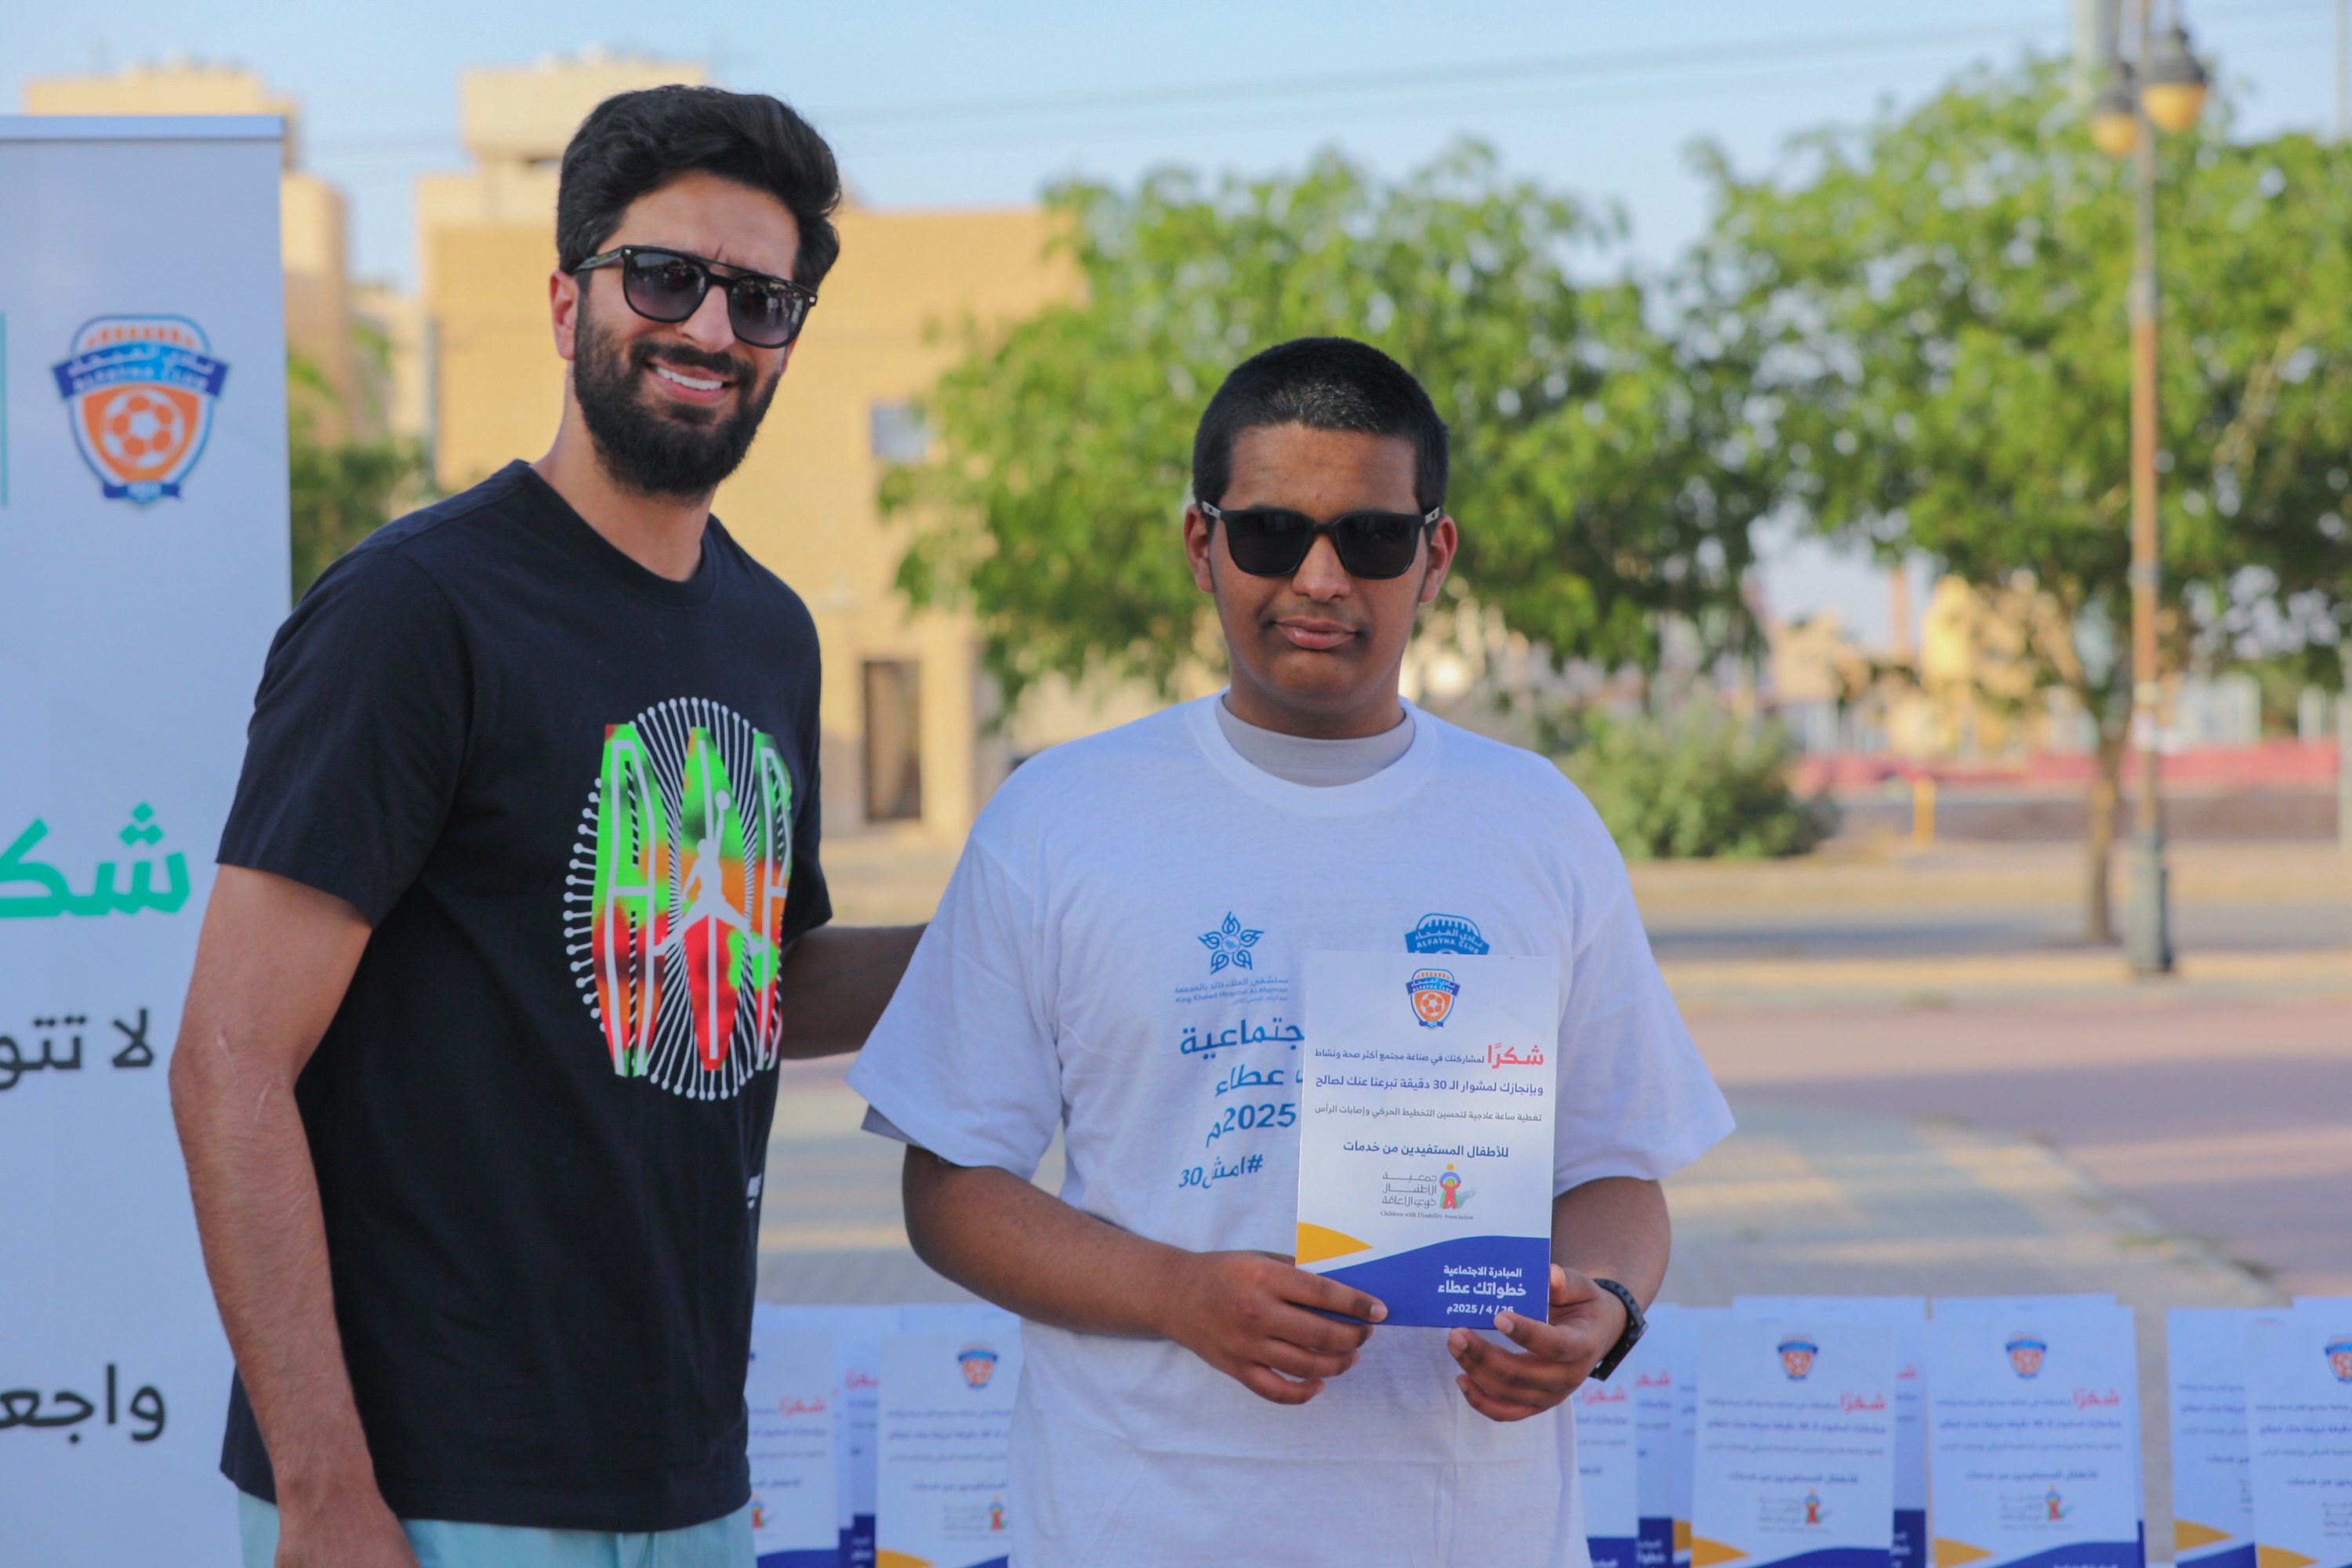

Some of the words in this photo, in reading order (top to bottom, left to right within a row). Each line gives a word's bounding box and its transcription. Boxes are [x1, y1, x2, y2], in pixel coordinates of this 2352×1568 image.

[1417, 938, 1456, 949] ALFAYHA
[1458, 940, 1479, 954] CLUB
[111, 1007, 154, 1069] لا
[1315, 1048, 1341, 1059] ونشاط
[1342, 1050, 1360, 1058] صحة
[1362, 1049, 1378, 1061] أكثر
[1379, 1052, 1405, 1062] مجتمع
[1430, 1053, 1443, 1066] في
[1444, 1054, 1485, 1065] لمشاركتك
[1487, 1042, 1544, 1069] شكرًا
[1214, 1063, 1284, 1098] عطاء
[1315, 1074, 1345, 1087] لصالح
[1346, 1076, 1368, 1087] عنك
[1370, 1076, 1398, 1091] تبرعنا
[1399, 1077, 1430, 1091] دقيقة
[1432, 1079, 1447, 1090] 30
[1460, 1080, 1497, 1094] لمشوار
[1499, 1082, 1544, 1097] وبإنجازك
[1314, 1103, 1338, 1114] الرأس
[1338, 1105, 1370, 1117] وإصابات
[1371, 1106, 1400, 1119] الحركي
[1403, 1108, 1436, 1119] التخطيط
[1436, 1109, 1467, 1120] لتحسين
[1468, 1111, 1494, 1122] علاجية
[1494, 1112, 1515, 1121] ساعة
[1516, 1112, 1543, 1123] تغطية
[1343, 1141, 1380, 1152] خدمات
[1382, 1145, 1398, 1154] من
[1401, 1143, 1465, 1157] المستفيدين
[1467, 1145, 1509, 1159] للأطفال
[1443, 1265, 1487, 1277] الاجتماعية
[1488, 1266, 1523, 1279] المبادرة
[1437, 1279, 1470, 1294] عطاء
[1472, 1281, 1527, 1299] خطواتك
